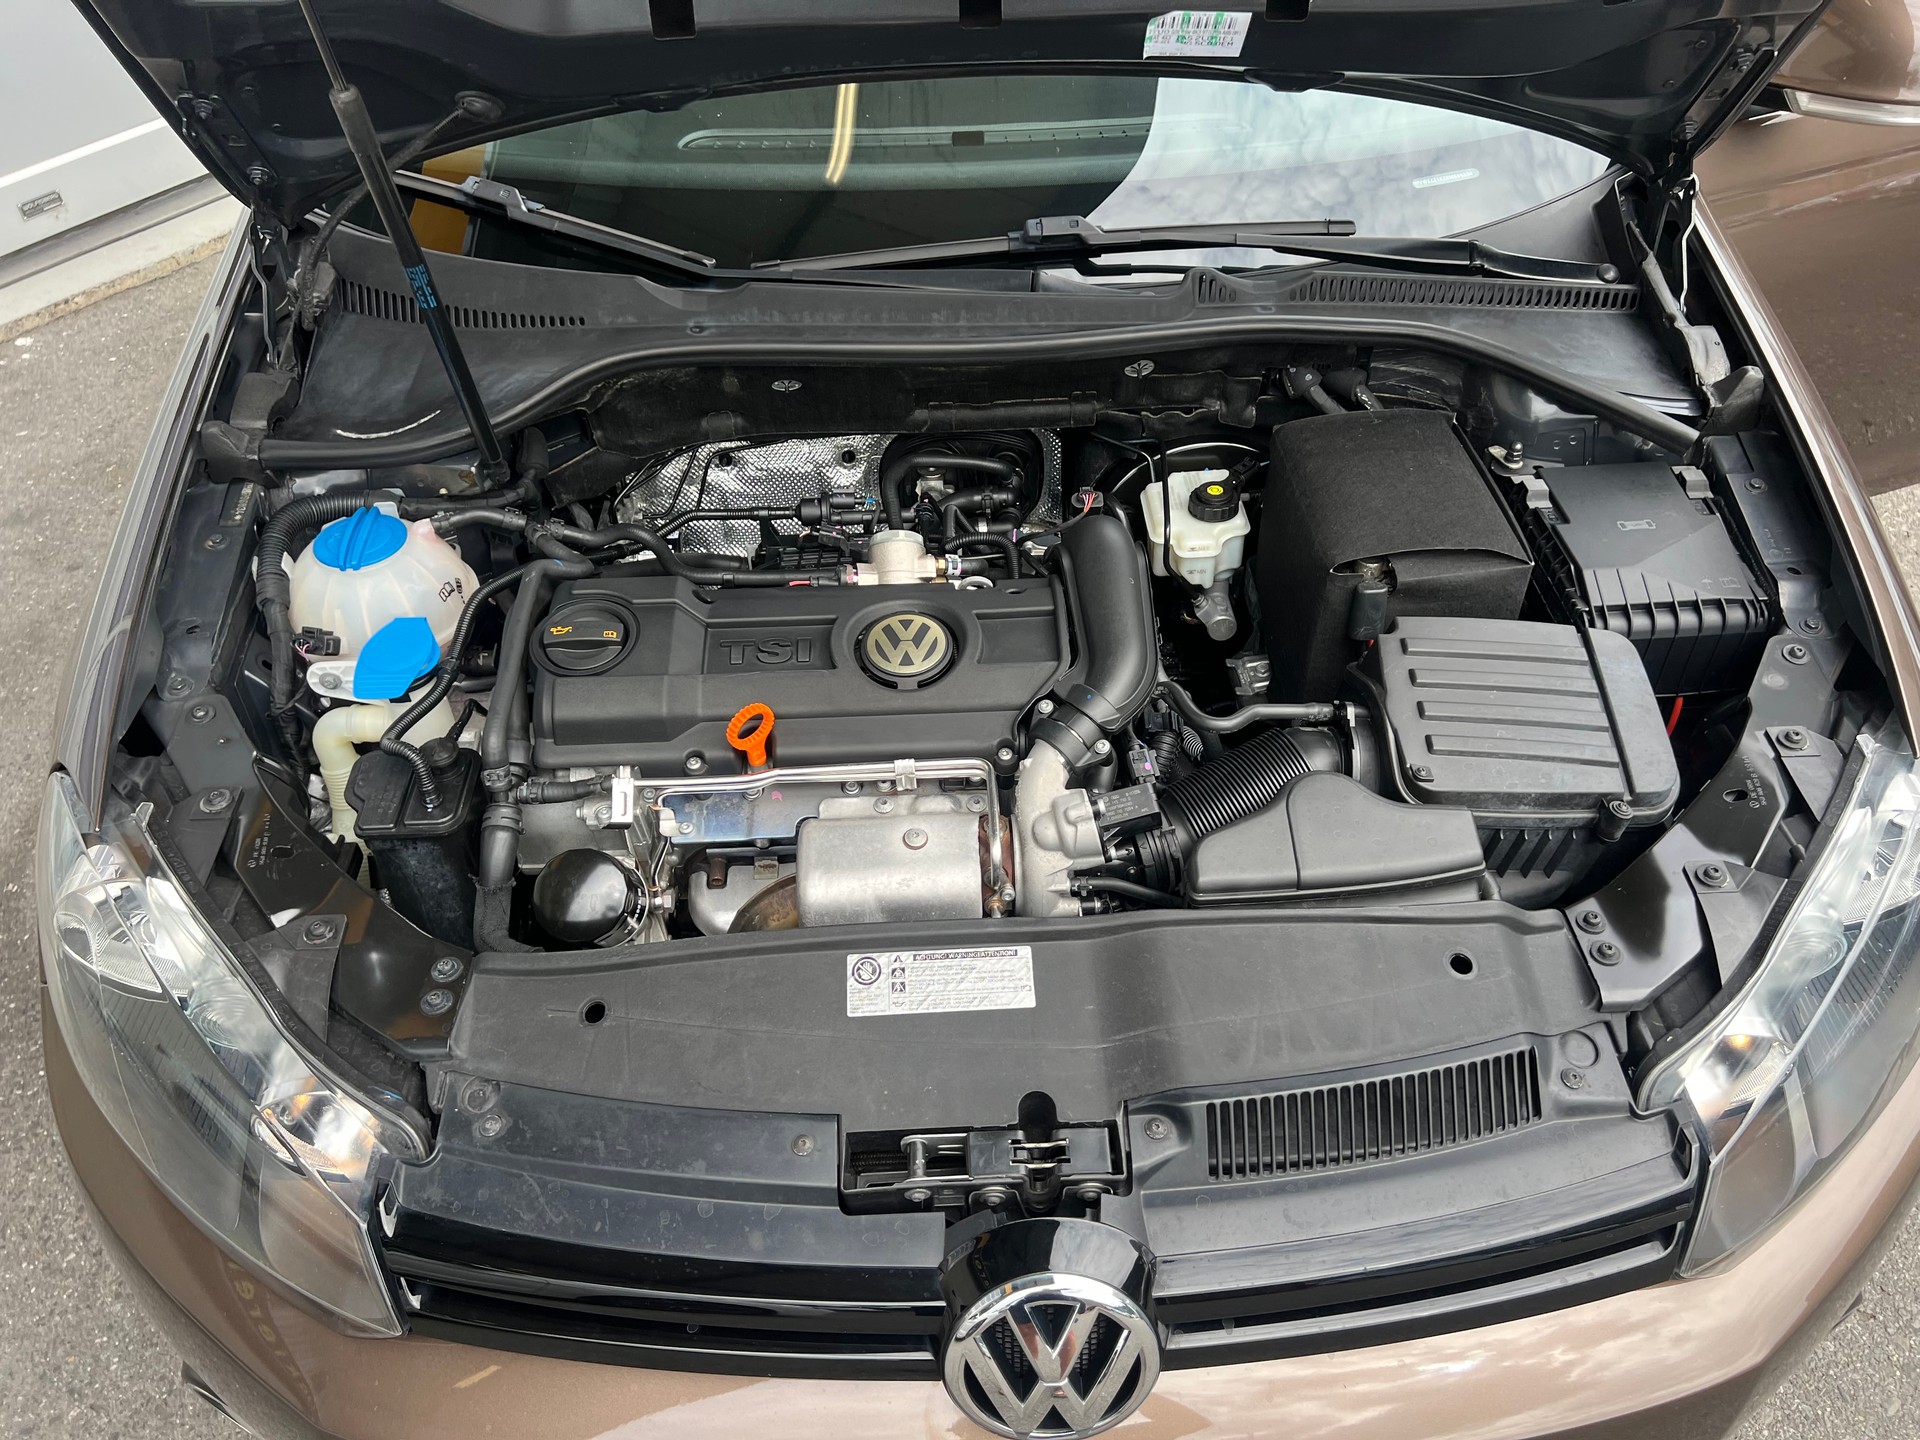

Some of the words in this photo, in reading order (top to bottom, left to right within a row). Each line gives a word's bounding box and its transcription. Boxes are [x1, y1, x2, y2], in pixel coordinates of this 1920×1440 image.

[720, 637, 813, 666] TSI
[866, 613, 947, 674] VW
[915, 953, 948, 961] ACHTUNG!
[948, 951, 980, 960] WARNING!
[980, 949, 1017, 958] ATTENTION!
[944, 1273, 1161, 1440] VW
